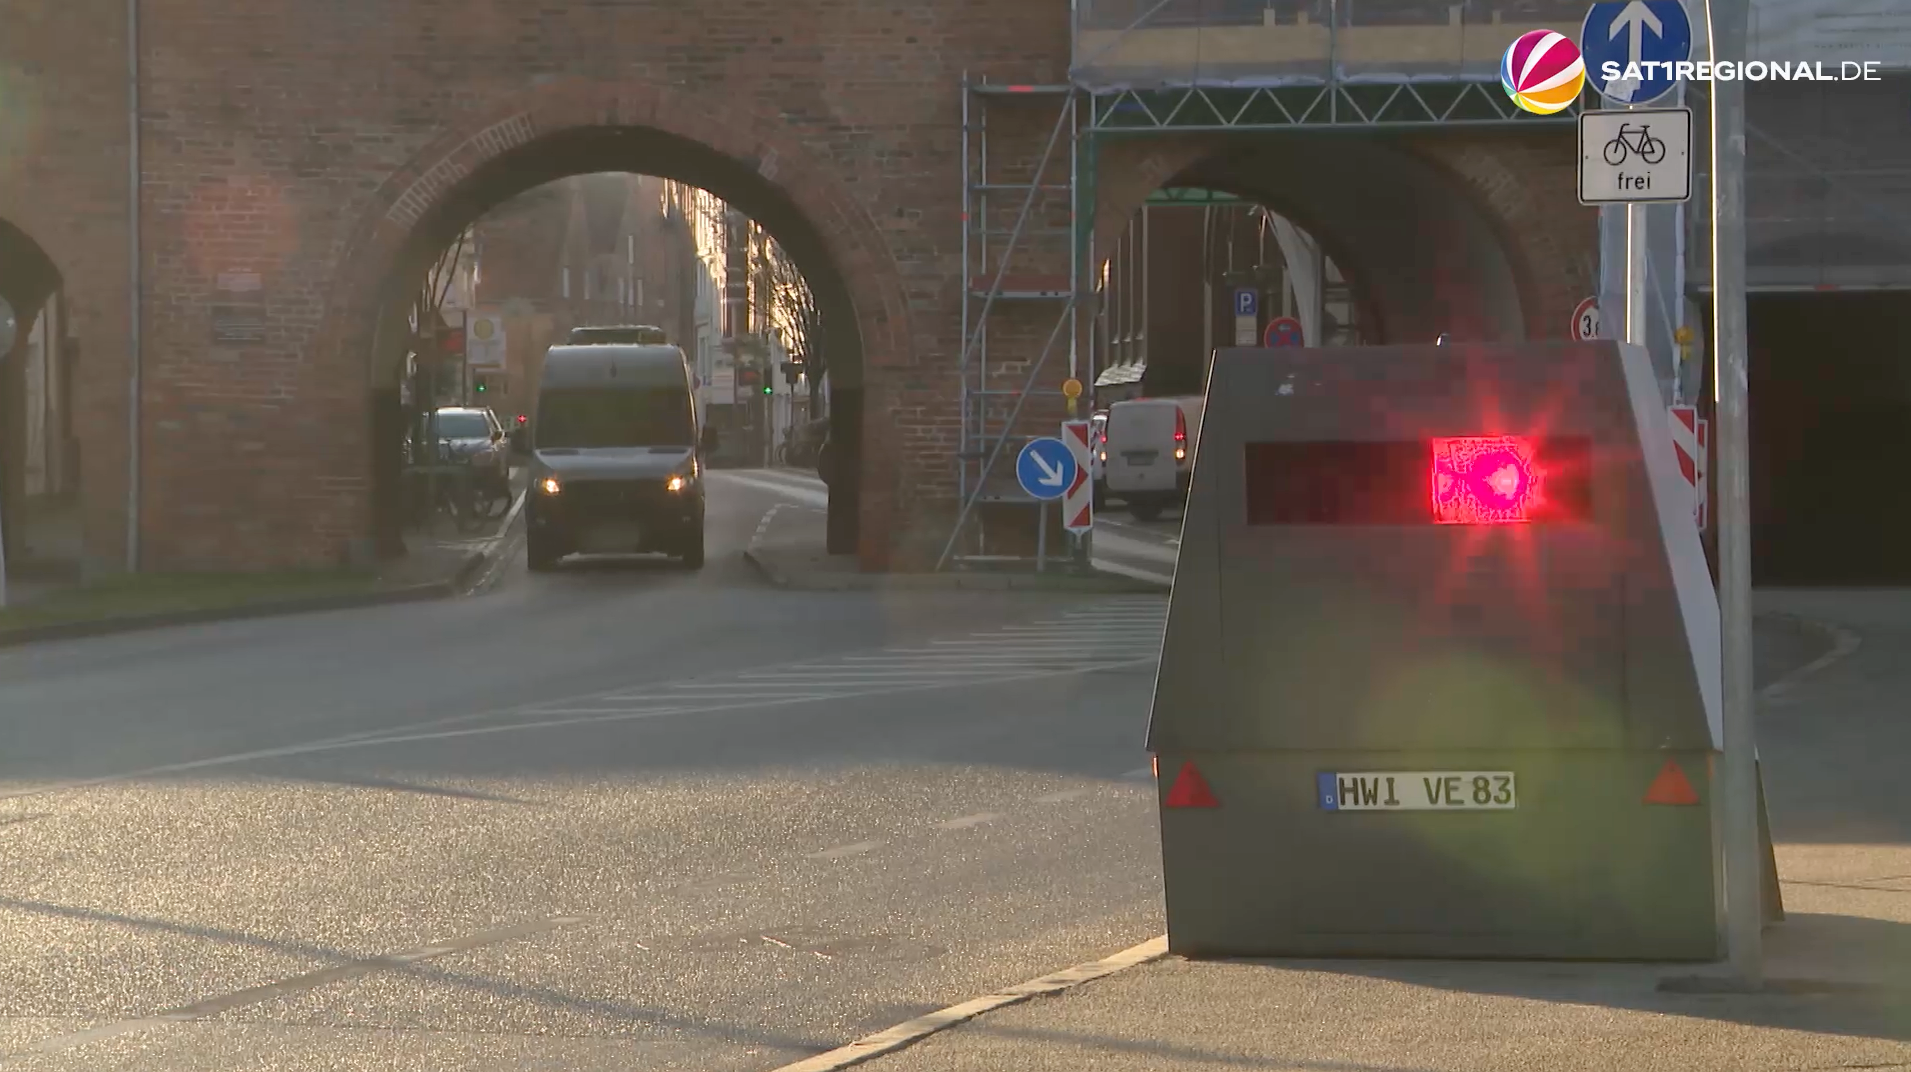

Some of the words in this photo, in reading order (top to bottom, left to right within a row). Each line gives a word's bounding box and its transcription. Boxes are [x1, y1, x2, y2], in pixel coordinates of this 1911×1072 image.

[1618, 171, 1651, 190] frei
[1240, 292, 1253, 313] P
[1338, 777, 1400, 806] HWI
